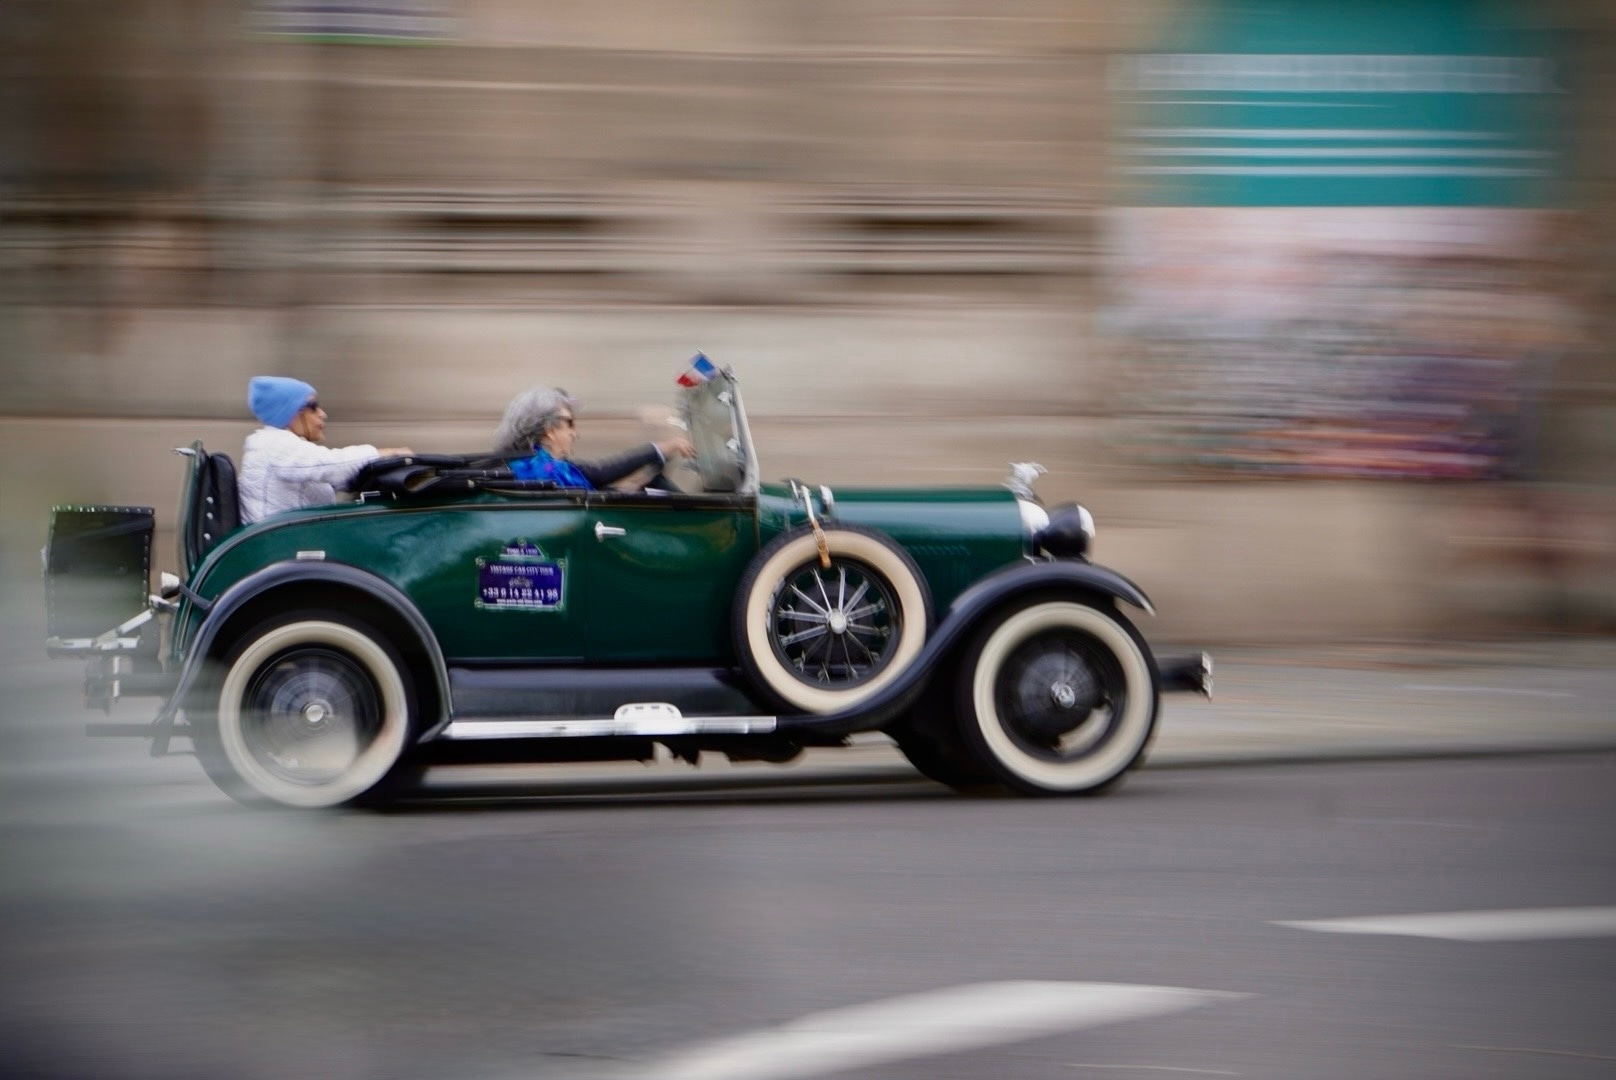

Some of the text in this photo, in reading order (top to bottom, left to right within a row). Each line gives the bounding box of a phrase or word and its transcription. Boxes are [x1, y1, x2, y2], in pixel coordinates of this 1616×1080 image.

[490, 564, 554, 576] VINTAGE CAR CITY TOUR
[483, 588, 499, 598] +33
[501, 588, 506, 598] 6
[510, 588, 519, 598] 14
[522, 588, 532, 599] 22
